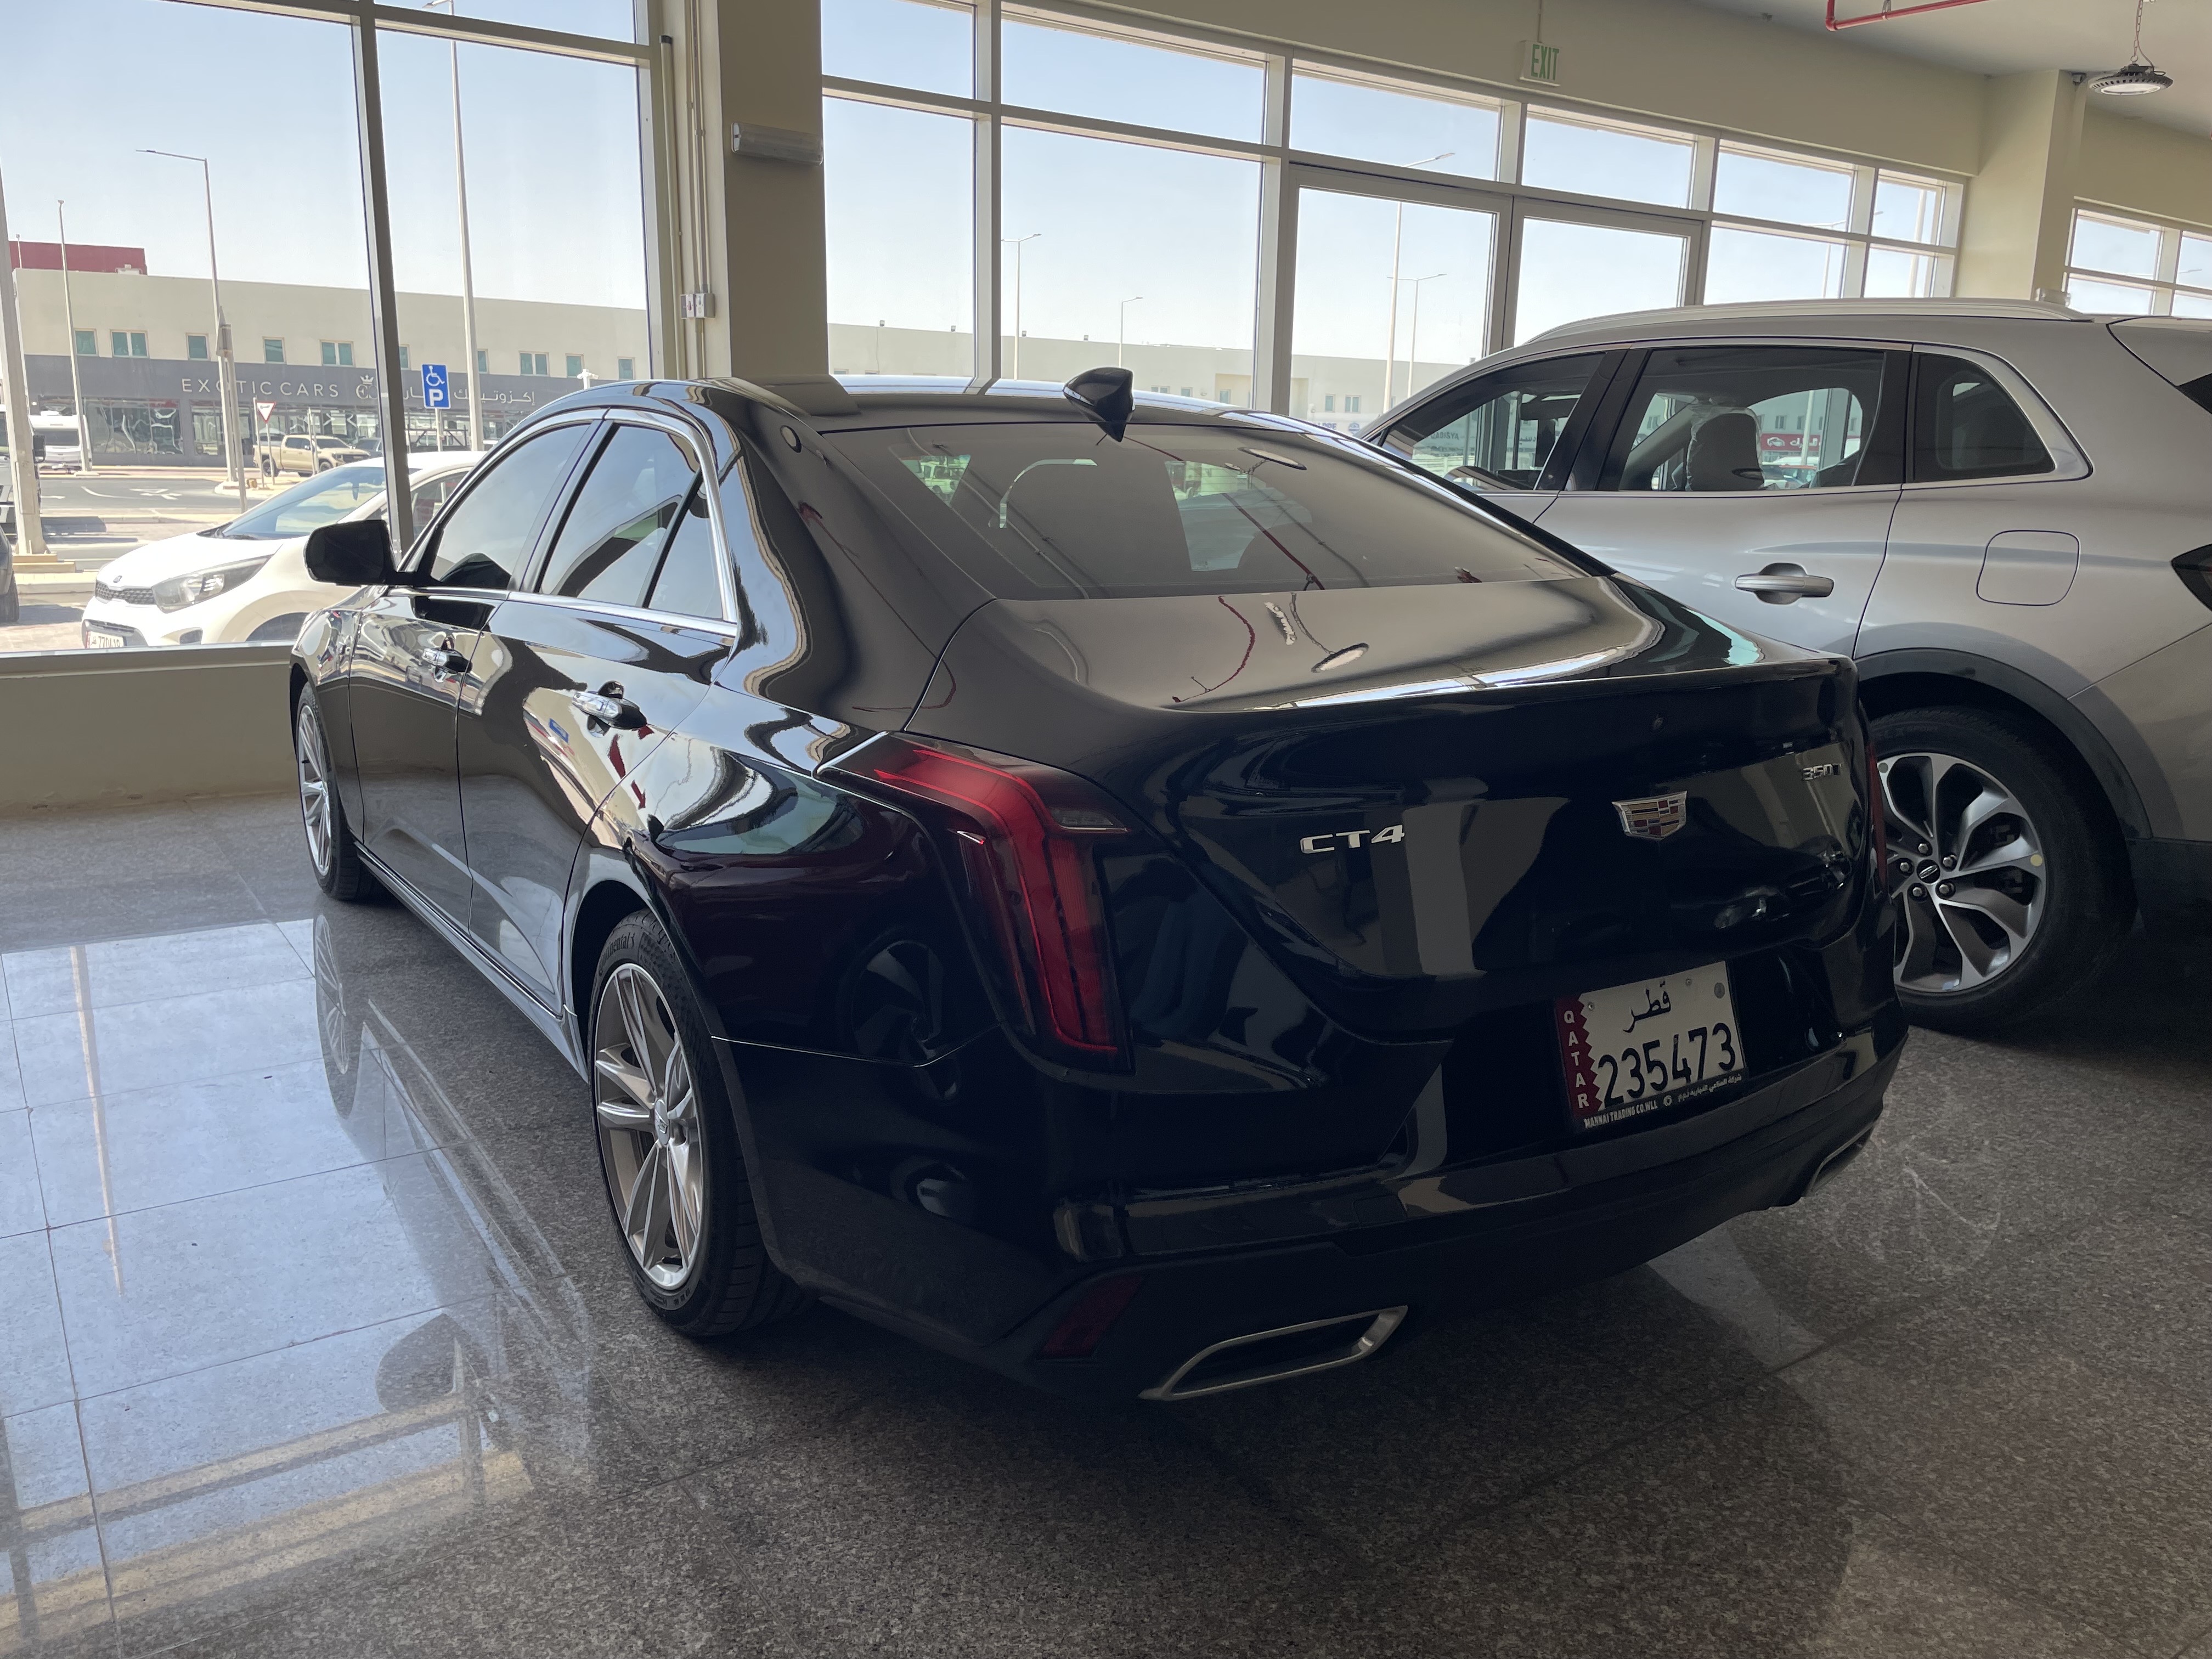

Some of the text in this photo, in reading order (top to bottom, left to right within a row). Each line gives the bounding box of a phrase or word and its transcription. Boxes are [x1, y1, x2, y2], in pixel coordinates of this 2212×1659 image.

[1531, 43, 1560, 81] EXIT
[182, 378, 339, 398] EXTIC CARS
[429, 388, 443, 407] P
[1300, 825, 1405, 854] CT4
[1622, 980, 1671, 1033] قطر
[1564, 1010, 1590, 1109] QATAR
[1598, 1022, 1736, 1108] 235473
[1583, 1113, 1610, 1129] MANNAI
[1609, 1106, 1636, 1122] TRADING
